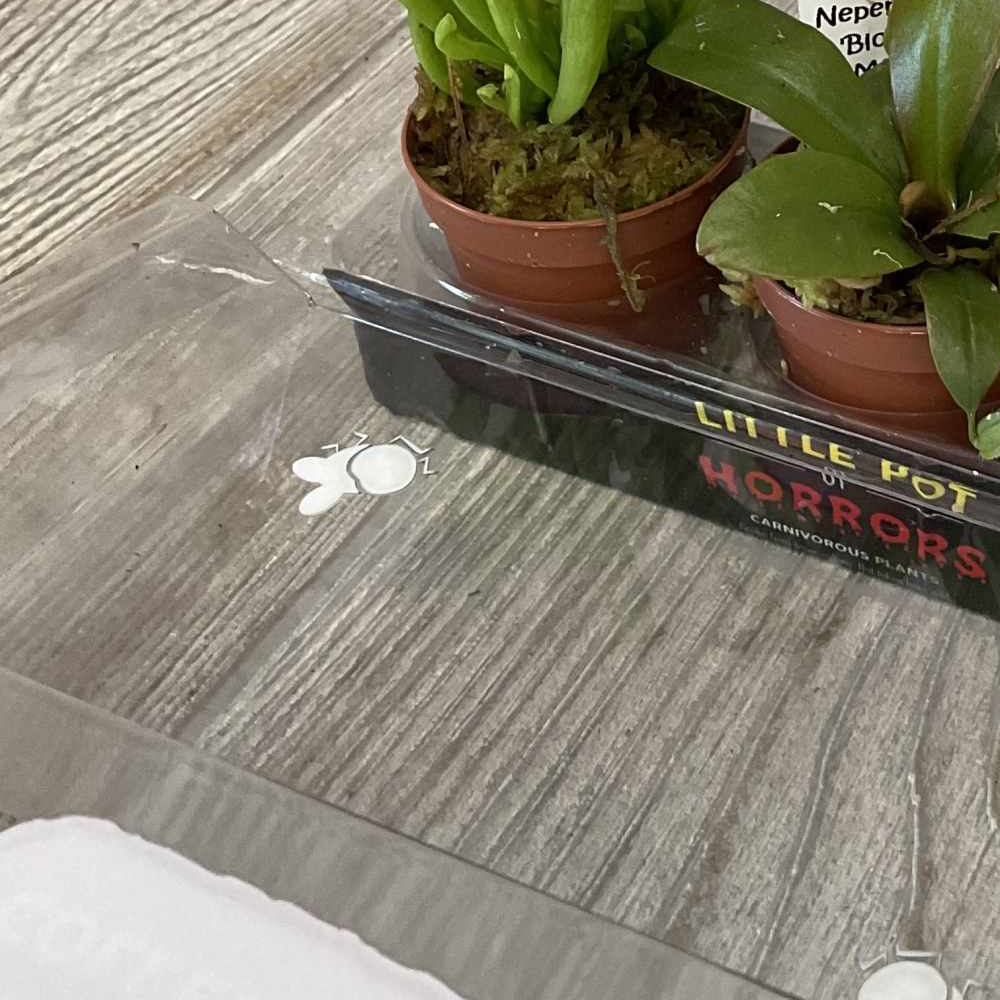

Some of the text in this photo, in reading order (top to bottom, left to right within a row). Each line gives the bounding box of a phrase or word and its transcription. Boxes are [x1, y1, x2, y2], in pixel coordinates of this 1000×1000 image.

[699, 455, 988, 585] HORRORS
[880, 459, 977, 514] POT
[750, 513, 940, 585] CARNIVOROUS PLANTS
